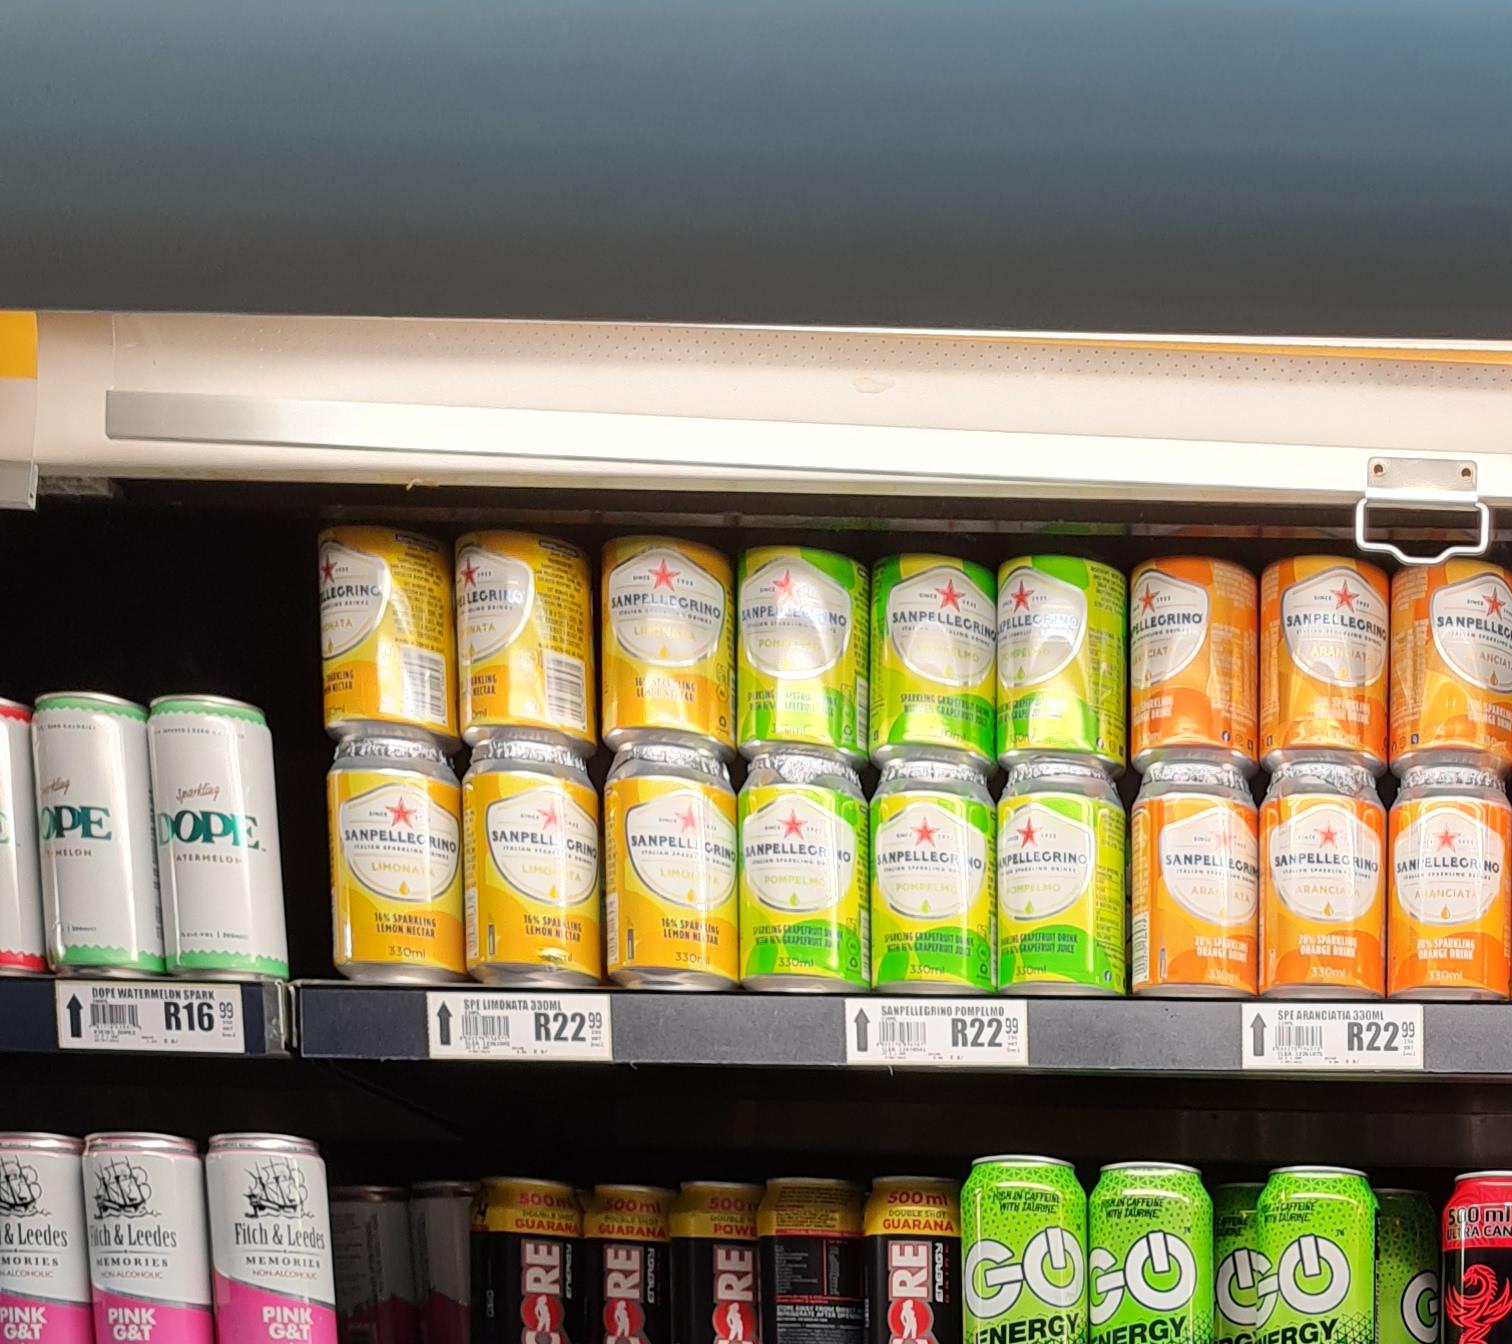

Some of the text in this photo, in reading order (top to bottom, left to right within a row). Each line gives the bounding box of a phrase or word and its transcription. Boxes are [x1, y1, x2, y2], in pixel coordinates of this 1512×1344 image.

[92, 989, 215, 1001] DOPE WATERMELON SPARK
[484, 1001, 528, 1011] LIMONATA
[530, 1001, 563, 1012] 330ML
[164, 1002, 234, 1032] R16 99
[535, 1012, 603, 1042] R22 99
[882, 1218, 954, 1232] GUARANA
[235, 1223, 267, 1246] Fitch
[272, 1225, 284, 1246] &
[964, 1227, 1084, 1319] GO
[263, 1307, 313, 1325] PINK
[268, 1324, 310, 1340] G&T
